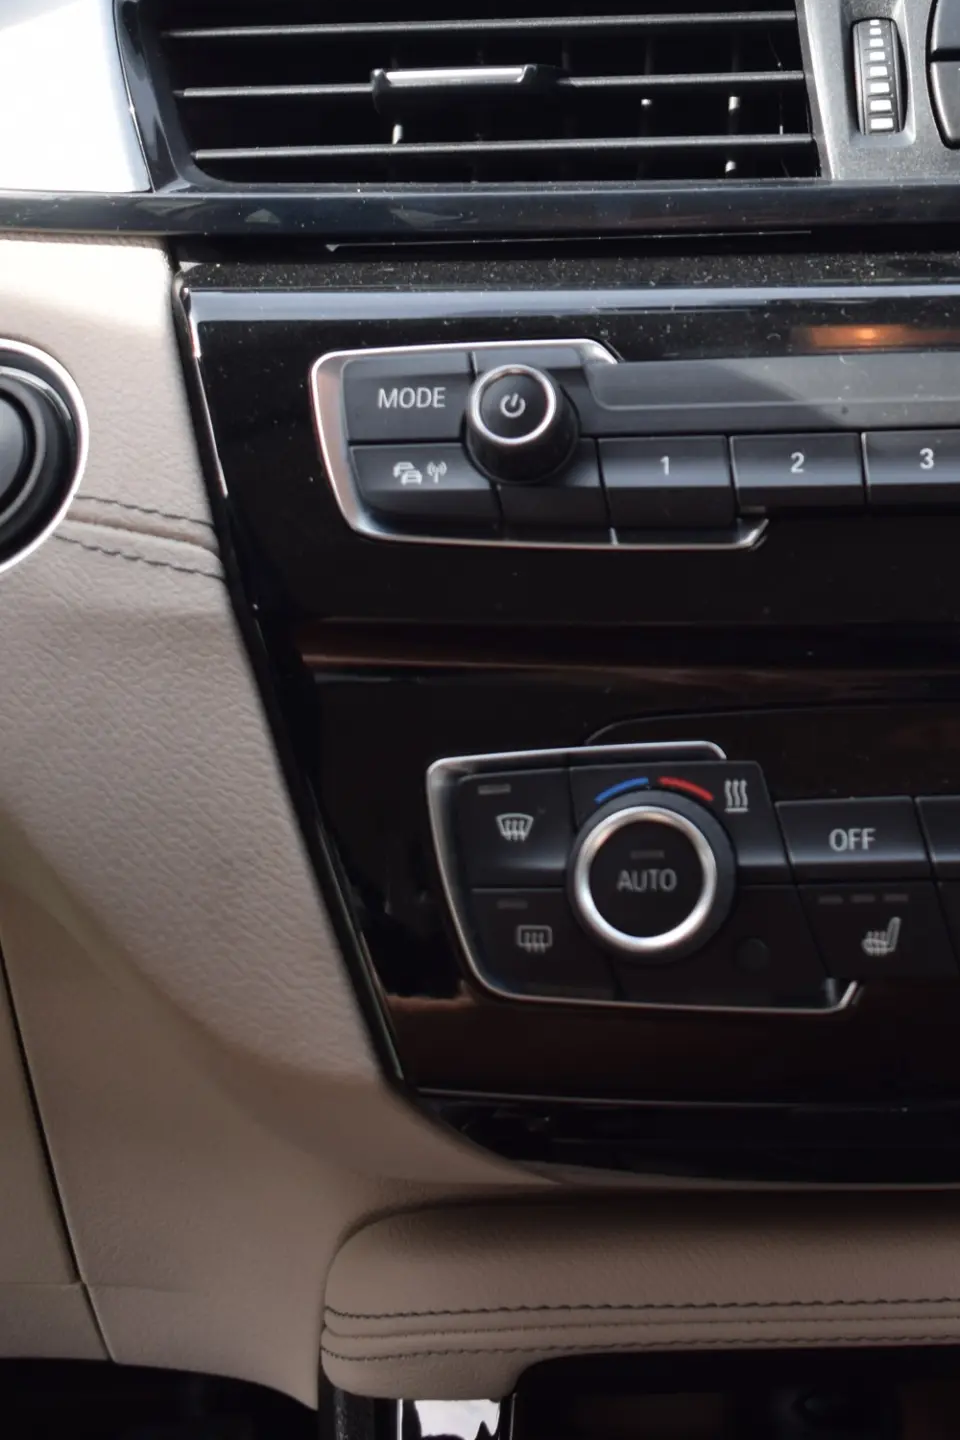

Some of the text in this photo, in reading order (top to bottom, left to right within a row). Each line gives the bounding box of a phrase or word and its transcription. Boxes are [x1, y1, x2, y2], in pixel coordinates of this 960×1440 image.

[377, 386, 446, 409] MODE
[660, 455, 670, 476] 1
[790, 451, 805, 473] 2
[919, 447, 934, 470] 3
[829, 828, 876, 852] OFF
[617, 868, 677, 892] AUTO
